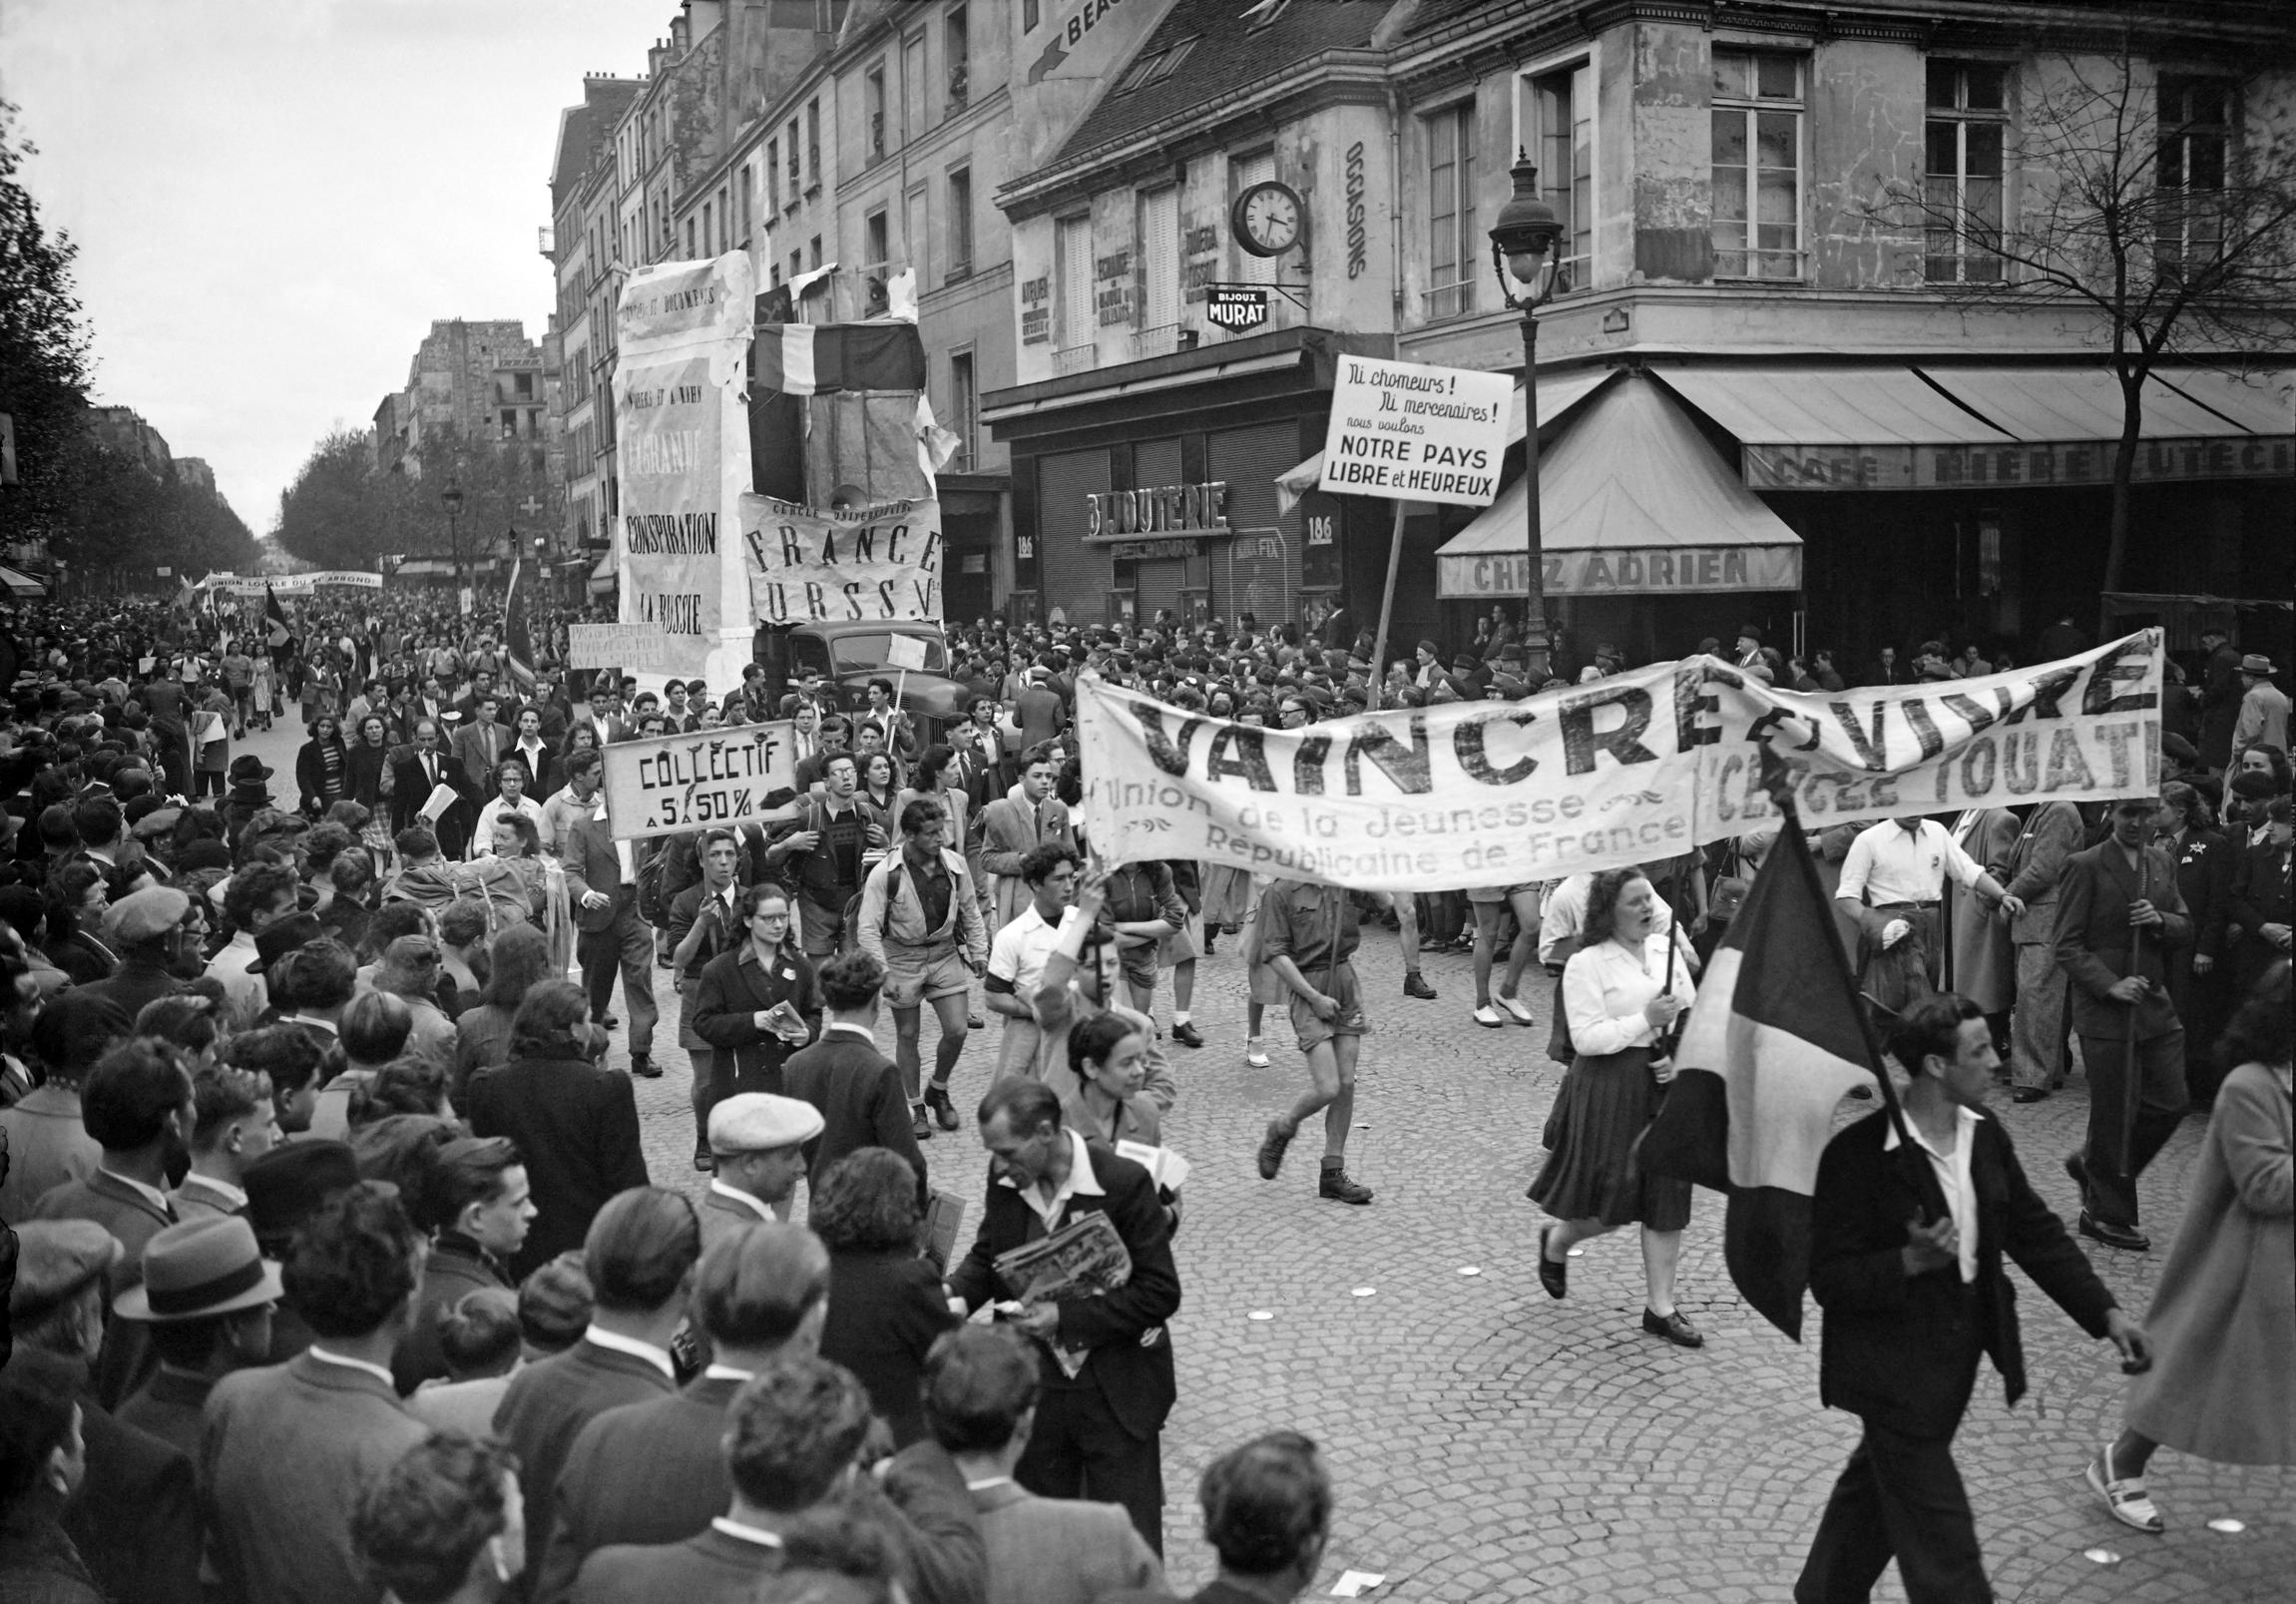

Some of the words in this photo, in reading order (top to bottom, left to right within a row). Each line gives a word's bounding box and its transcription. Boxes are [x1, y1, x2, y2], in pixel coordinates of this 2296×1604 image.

[1068, 0, 1121, 46] BEA
[1346, 141, 1366, 280] OCCASIONS
[1208, 303, 1265, 325] MURAT
[1218, 292, 1256, 302] BIJOUX
[1349, 363, 1365, 384] Ni
[1369, 368, 1445, 394] chomeurs
[1379, 391, 1397, 412] Ni
[1404, 398, 1488, 422] mercenaires
[1347, 416, 1373, 429] nous
[1378, 416, 1425, 435] voulons
[1340, 435, 1411, 461] NOTRE
[1423, 444, 1487, 469] PAYS
[1328, 461, 1390, 486] LIBRE
[1392, 470, 1405, 488] et
[1408, 469, 1493, 497] HEUREUX
[773, 504, 818, 519] CERCLE
[1309, 515, 1332, 540] 186
[628, 513, 716, 555] CONSPIRATION
[746, 525, 943, 573] FRANCE
[1018, 536, 1033, 555] 186
[1583, 552, 1746, 587] ADRIEN
[659, 594, 701, 635] RUSSIE
[1129, 666, 1744, 797] VAINCRE
[640, 742, 779, 790] COLLECTIF
[1935, 721, 2159, 801] TOUATI
[1106, 778, 1212, 816] Union
[1238, 802, 1283, 831] de
[1301, 806, 1338, 837] la
[1365, 794, 1585, 838] Jeunesse
[1205, 822, 1441, 877] Républicaine
[1461, 839, 1508, 870] de
[1529, 814, 1686, 863] France
